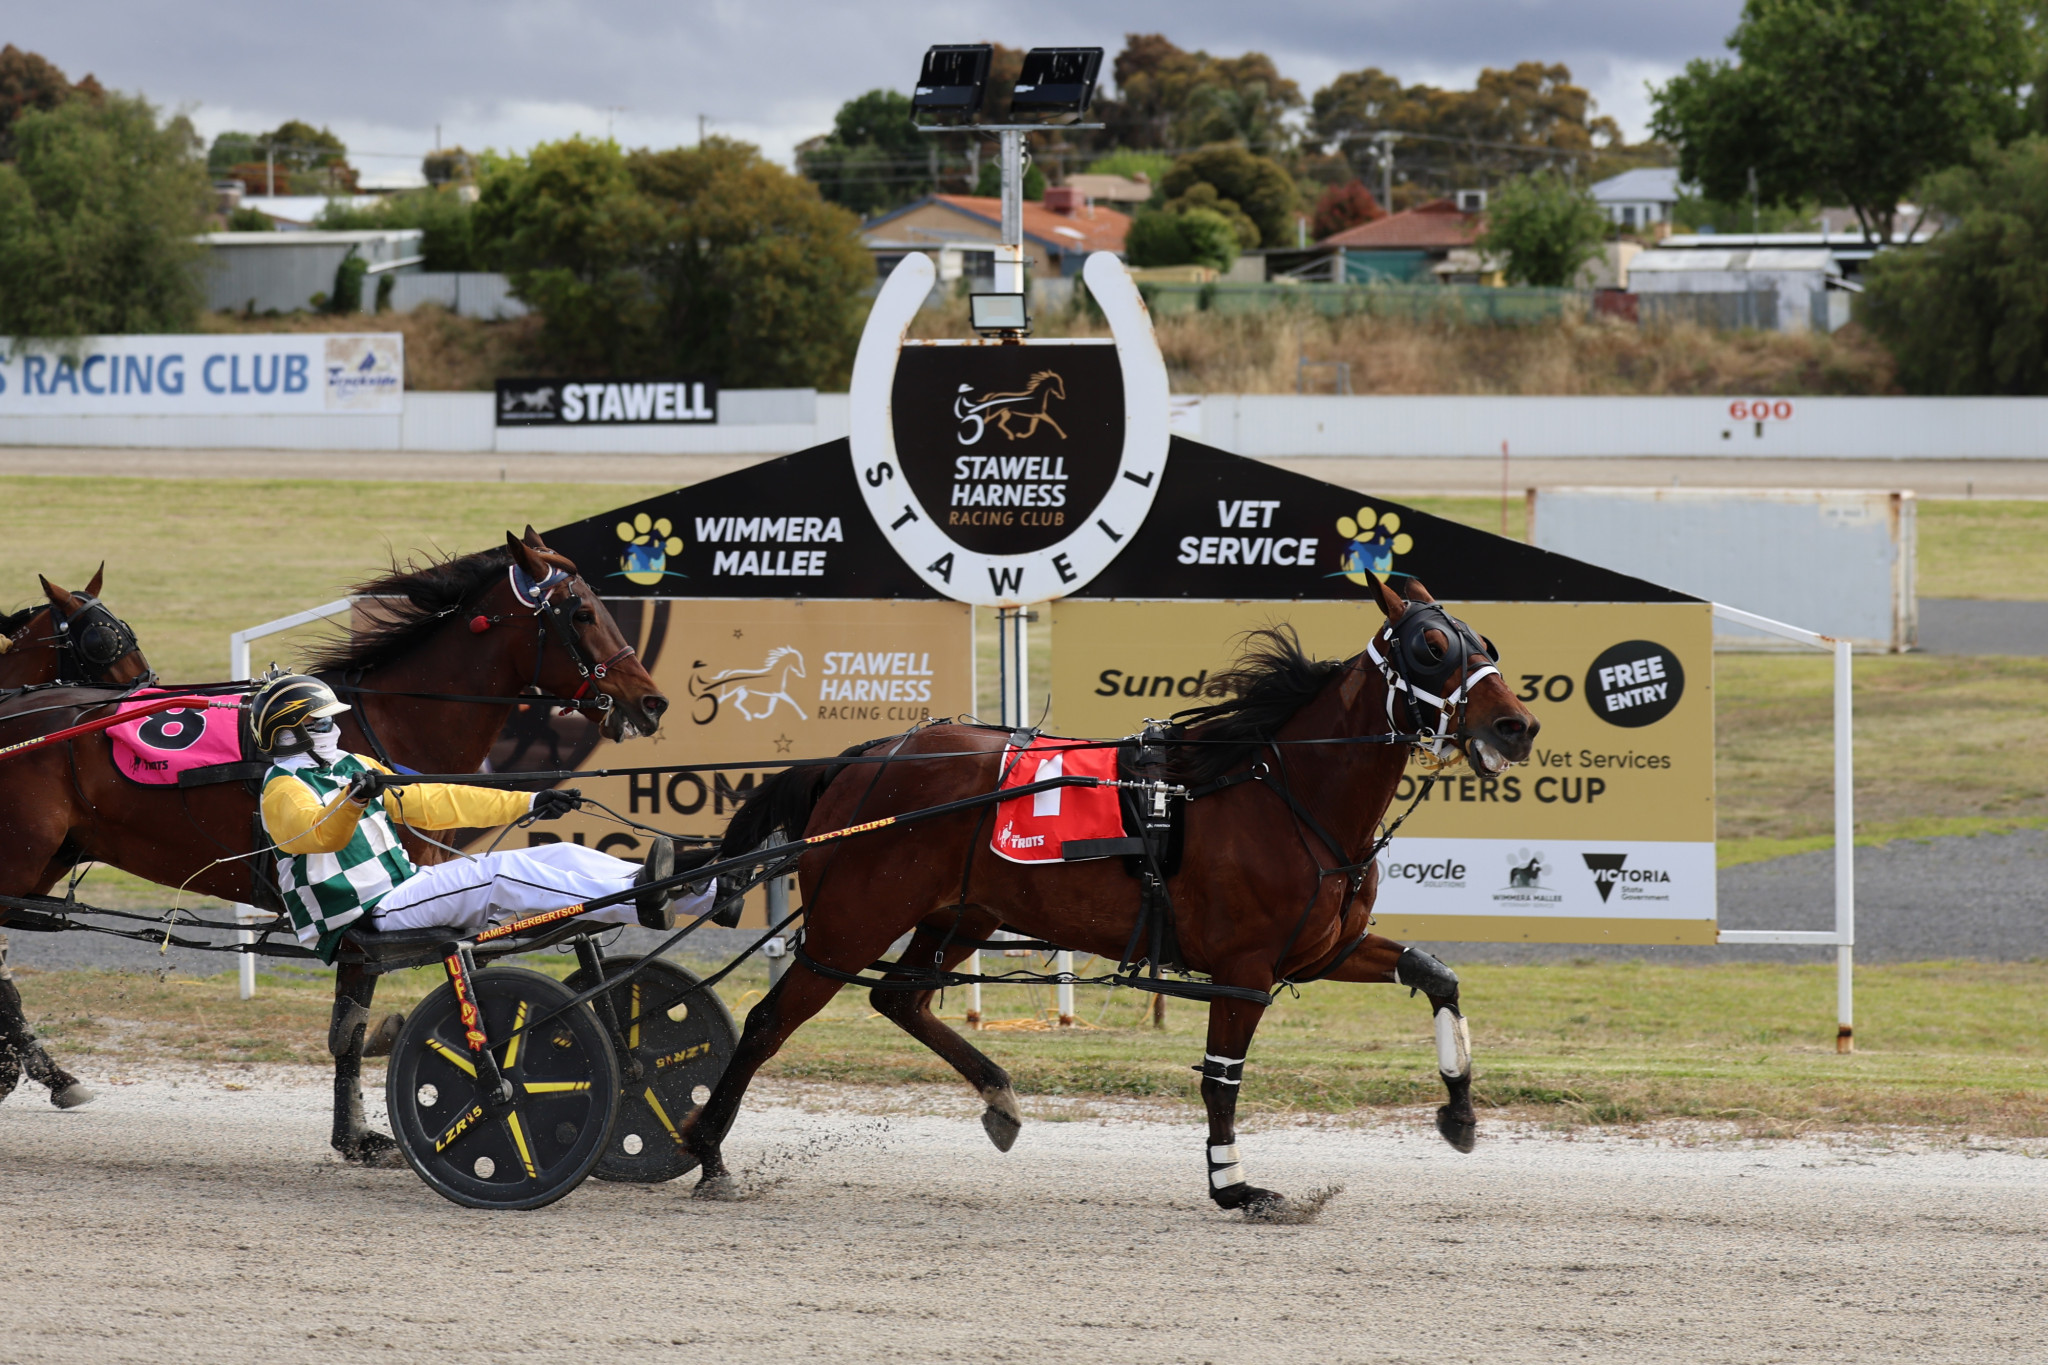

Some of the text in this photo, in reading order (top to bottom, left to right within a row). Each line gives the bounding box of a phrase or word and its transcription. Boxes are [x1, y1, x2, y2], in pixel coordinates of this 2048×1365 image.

[22, 354, 184, 395] RACING
[203, 354, 309, 395] CLUB
[562, 383, 714, 422] STAWELL
[1729, 400, 1793, 421] 600
[954, 456, 1068, 480] STAWELL
[951, 484, 1066, 507] HARNESS
[949, 511, 1064, 526] RACING CLUB
[1218, 500, 1281, 528] VET
[695, 517, 844, 543] WIMMERA
[866, 462, 1154, 597] STAWELL
[712, 551, 827, 576] MALLEE
[1177, 536, 1319, 566] SERVICE
[822, 651, 934, 676] STAWELL
[1599, 655, 1666, 692] FREE
[819, 679, 931, 702] HARNESS
[1094, 669, 1574, 702] Sunda 30
[1605, 682, 1669, 712] ENTRY
[818, 706, 930, 721] RACING CLUB
[136, 706, 207, 751] 8
[1536, 750, 1572, 768] Vet
[1579, 750, 1671, 769] Services
[629, 772, 778, 815] HOM
[1033, 753, 1064, 817] 1
[1534, 776, 1607, 804] CUP
[841, 816, 897, 837] ECLIPSE
[1011, 835, 1045, 848] TROTS
[1388, 859, 1466, 884] ecycle
[1589, 868, 1671, 884] VICTORIA
[478, 903, 585, 942] JAMES HERBERTSON
[435, 1118, 468, 1153] LZR
